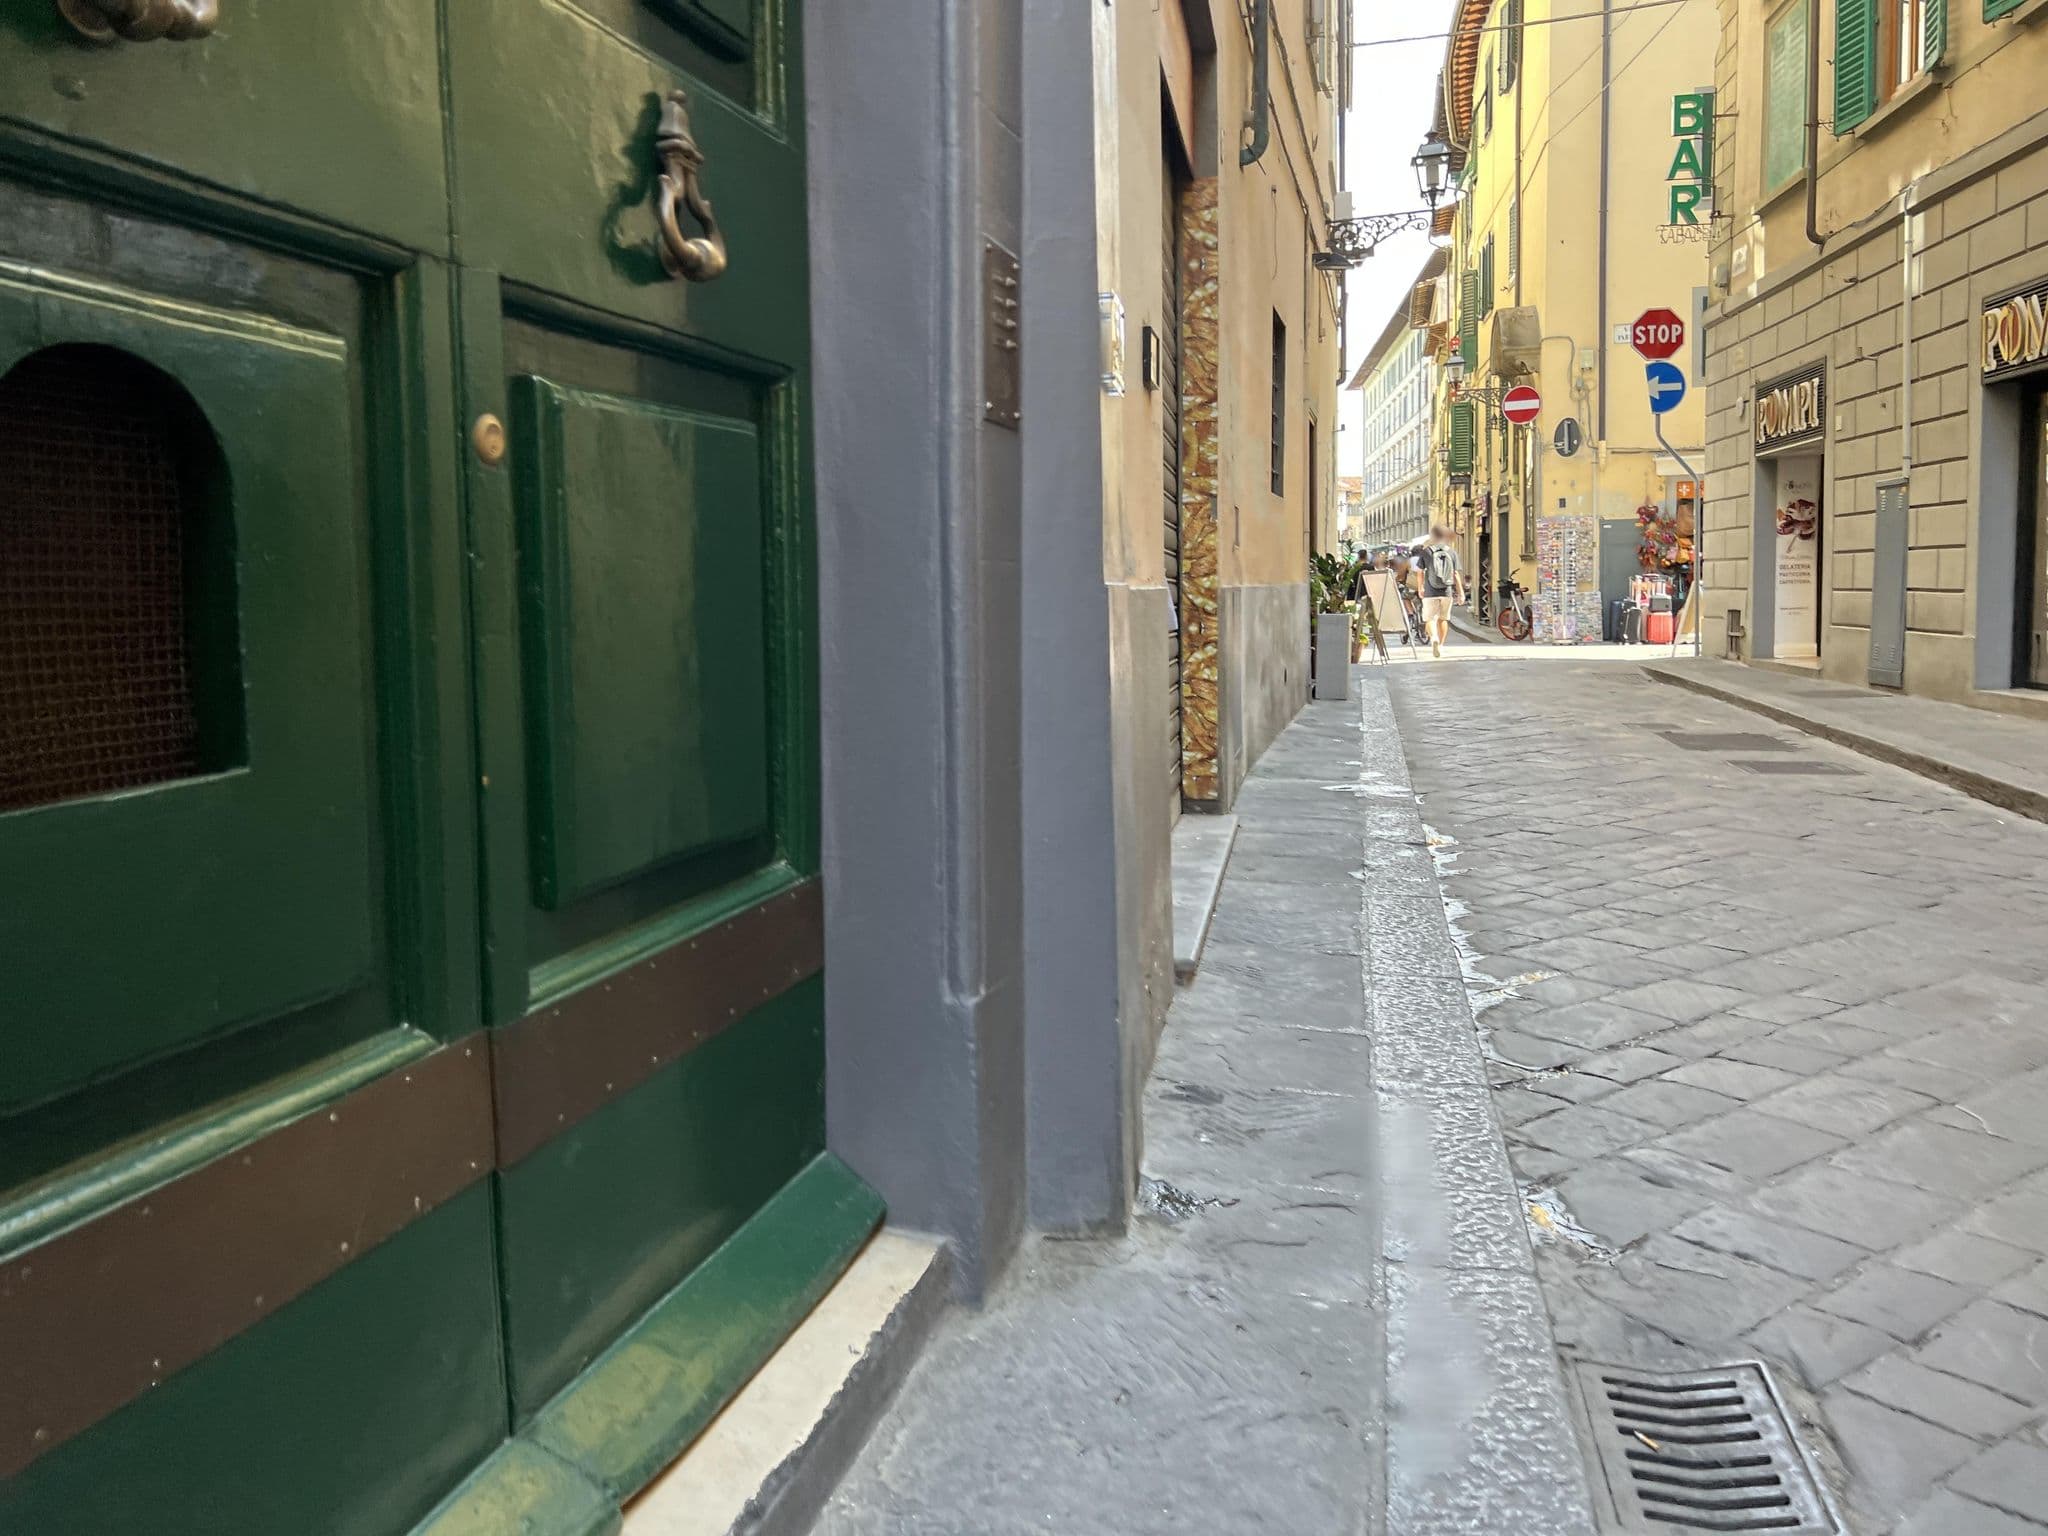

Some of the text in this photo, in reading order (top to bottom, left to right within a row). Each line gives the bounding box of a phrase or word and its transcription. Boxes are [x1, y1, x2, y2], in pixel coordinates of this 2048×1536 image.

[1667, 93, 1704, 225] BAR
[1635, 324, 1682, 344] STOP
[1755, 377, 1819, 443] POMPI
